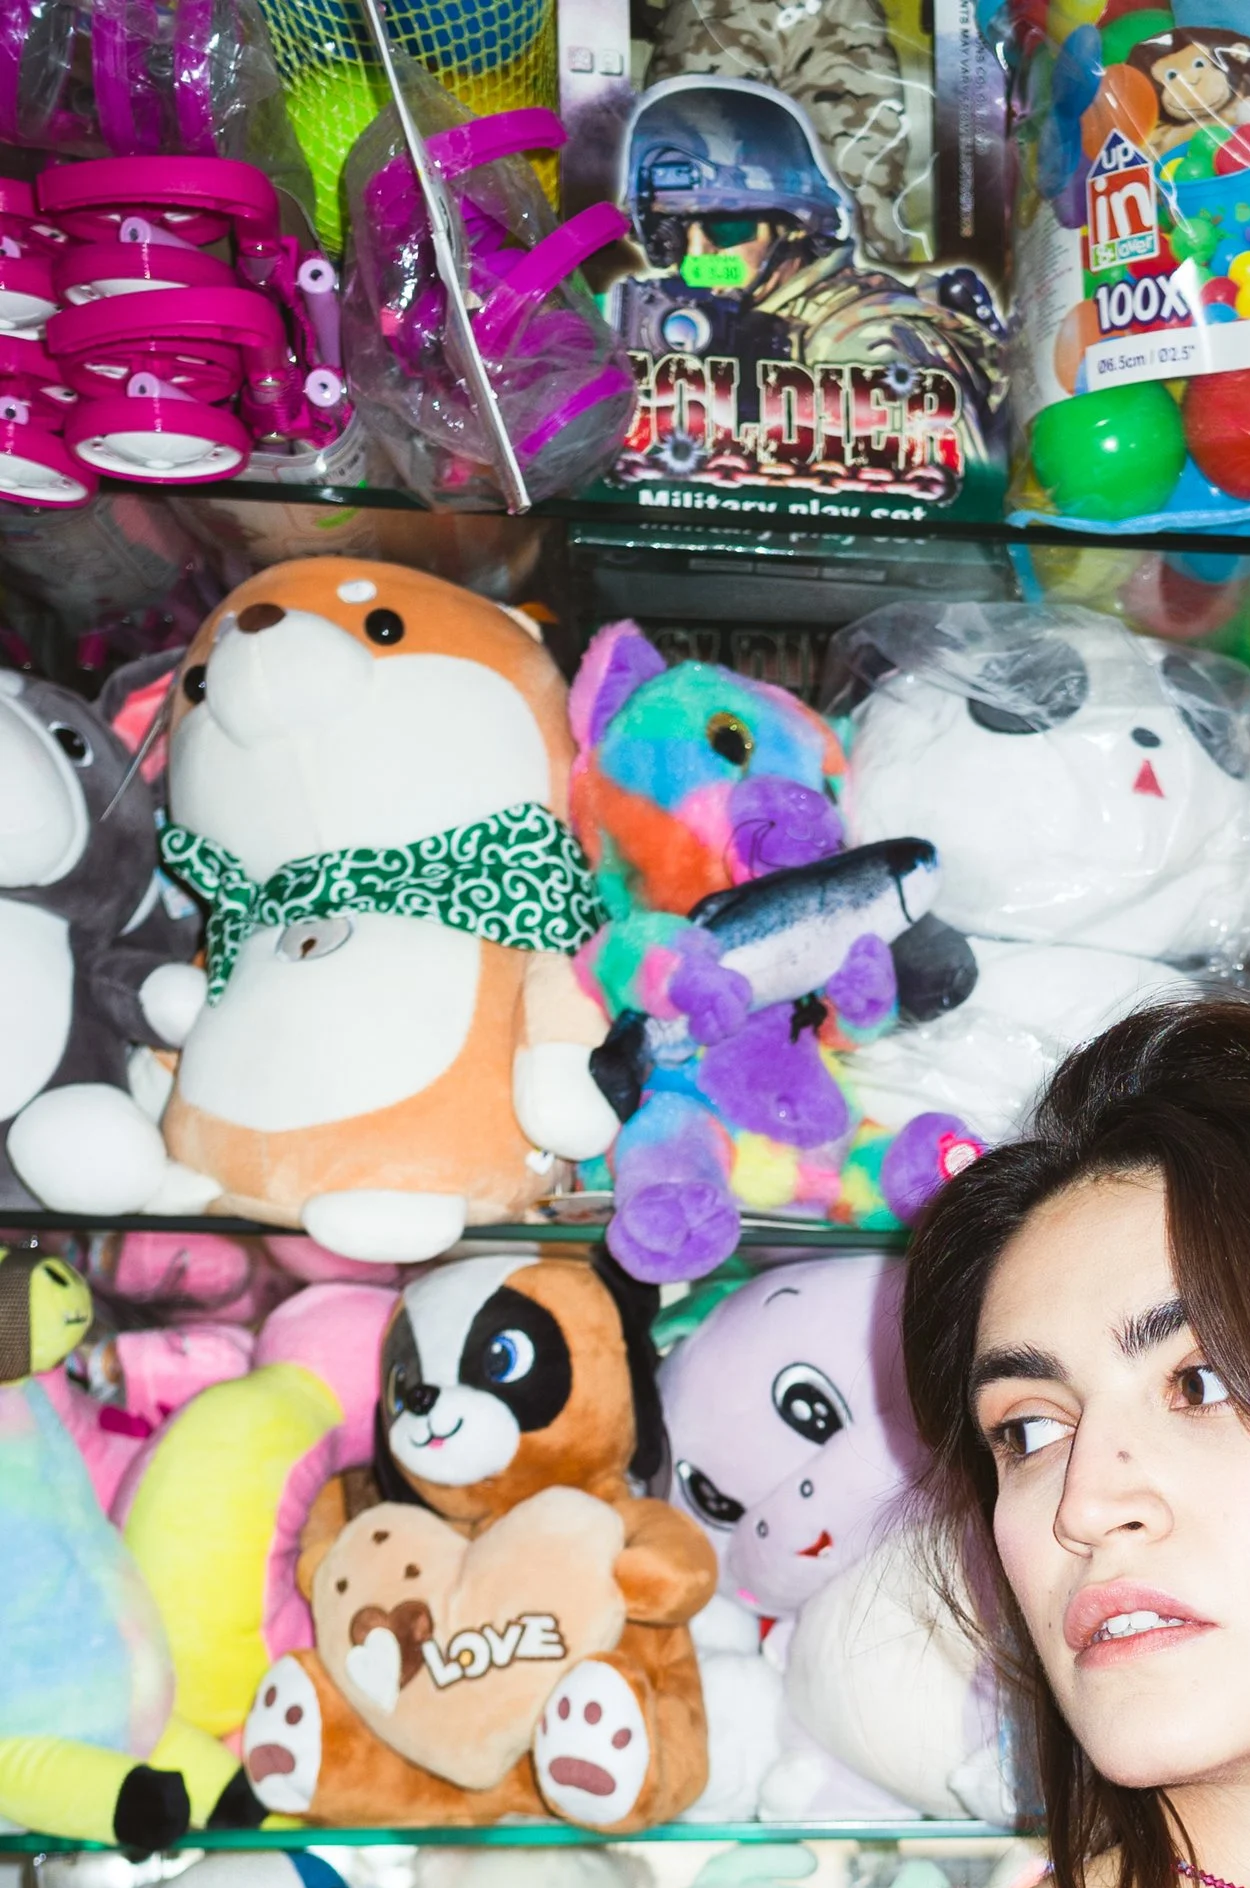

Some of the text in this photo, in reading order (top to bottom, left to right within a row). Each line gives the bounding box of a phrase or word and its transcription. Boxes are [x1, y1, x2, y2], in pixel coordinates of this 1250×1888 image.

[1101, 143, 1135, 170] up
[1094, 176, 1153, 242] in
[421, 1612, 569, 1690] LOVE
